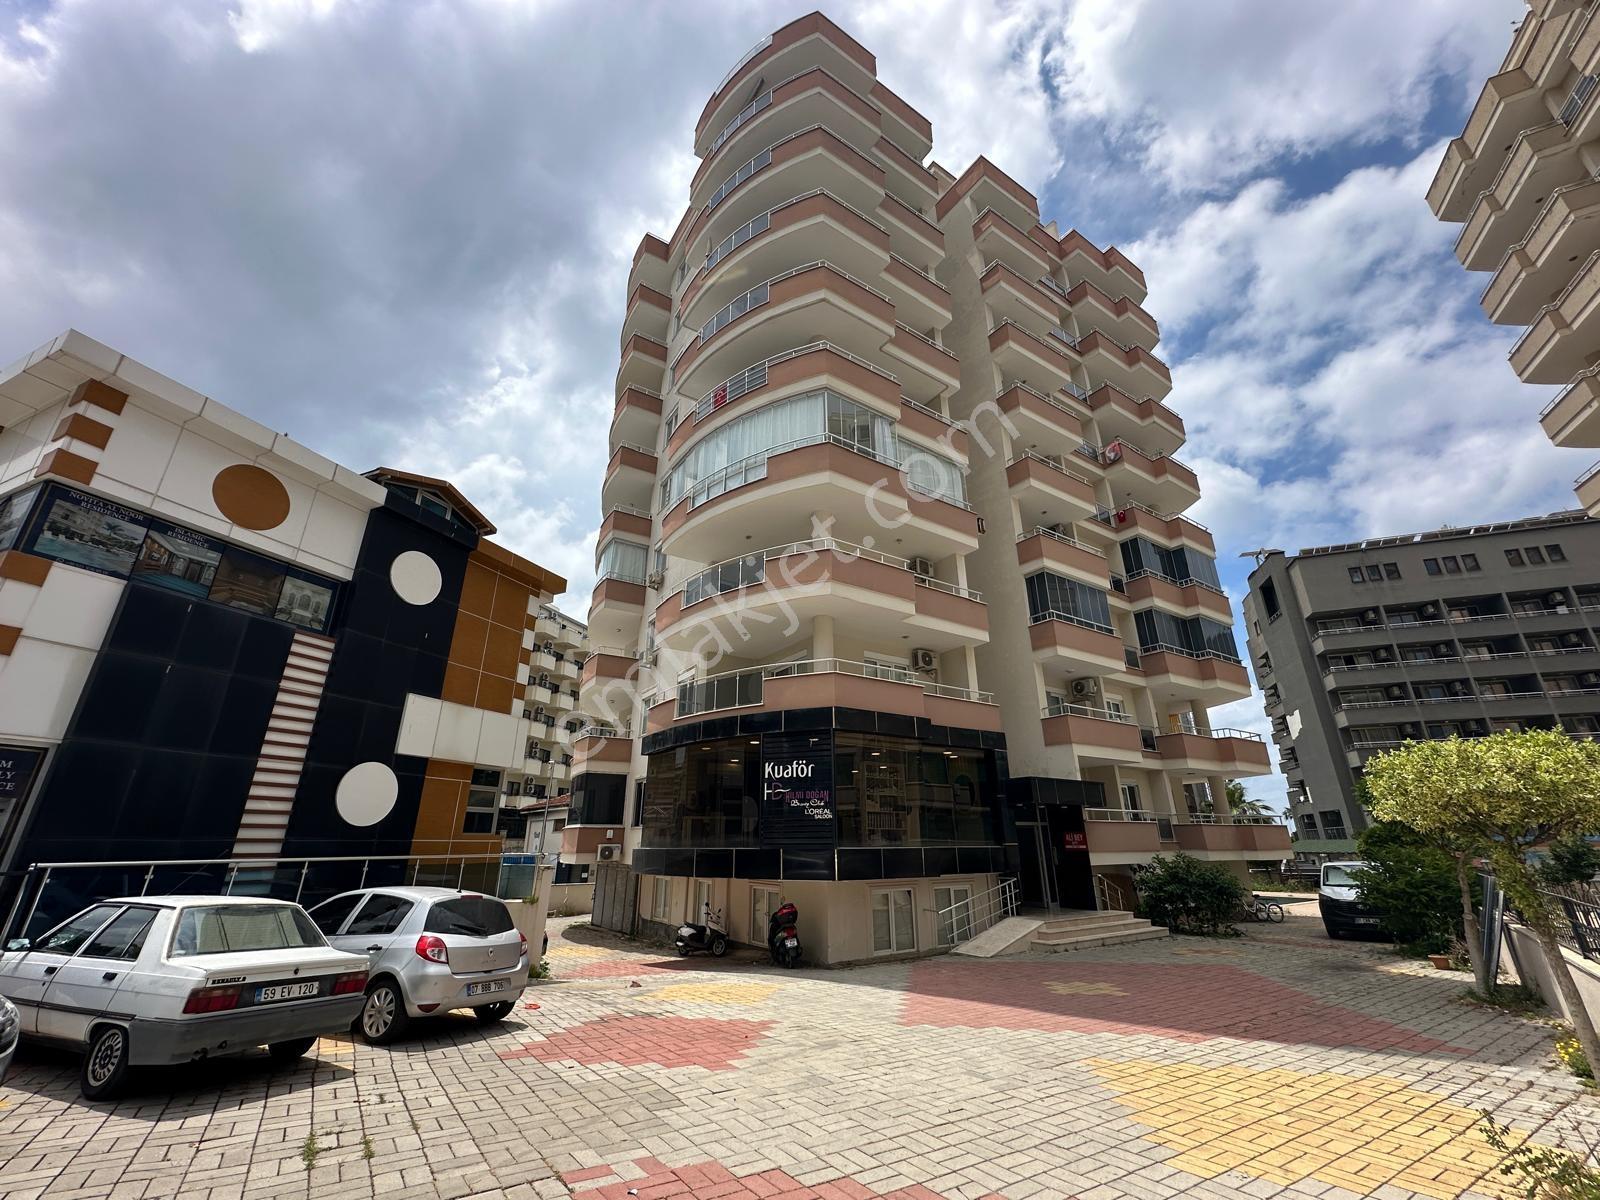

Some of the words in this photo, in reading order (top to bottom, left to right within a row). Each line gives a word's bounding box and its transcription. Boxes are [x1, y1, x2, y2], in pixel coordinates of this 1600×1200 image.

[81, 501, 130, 521] RESIDENCE
[120, 508, 144, 520] NOOR
[167, 530, 209, 548] RESIDENCE
[175, 528, 207, 541] ISLAMIC
[764, 760, 815, 780] Kuaför
[264, 988, 276, 1000] 59
[280, 986, 293, 998] EV
[299, 983, 314, 996] 120
